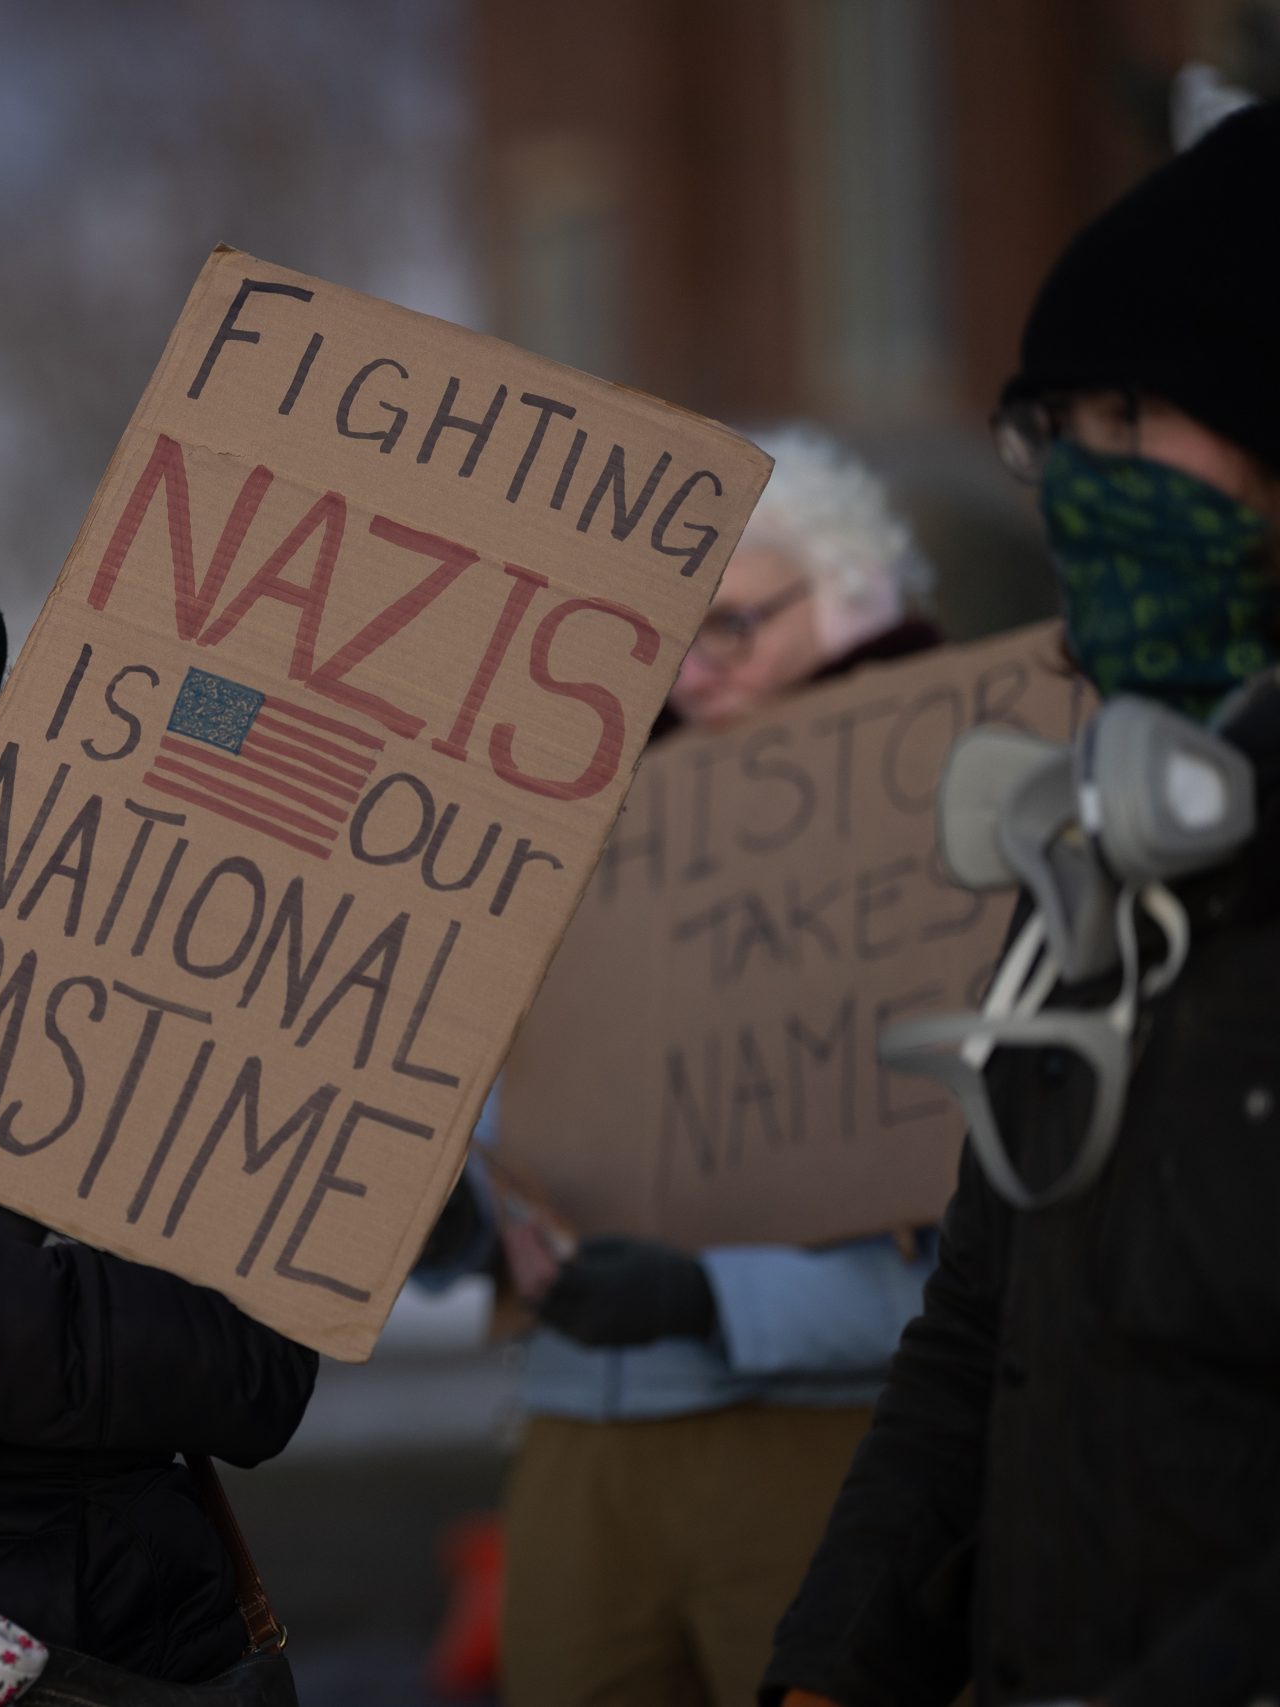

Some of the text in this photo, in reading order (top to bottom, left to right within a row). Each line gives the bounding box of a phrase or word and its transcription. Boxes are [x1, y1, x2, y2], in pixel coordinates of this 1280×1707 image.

[187, 278, 724, 578] FIGHTING
[45, 643, 160, 761] IS
[87, 433, 662, 801] NAZIS
[656, 965, 992, 1196] NAME
